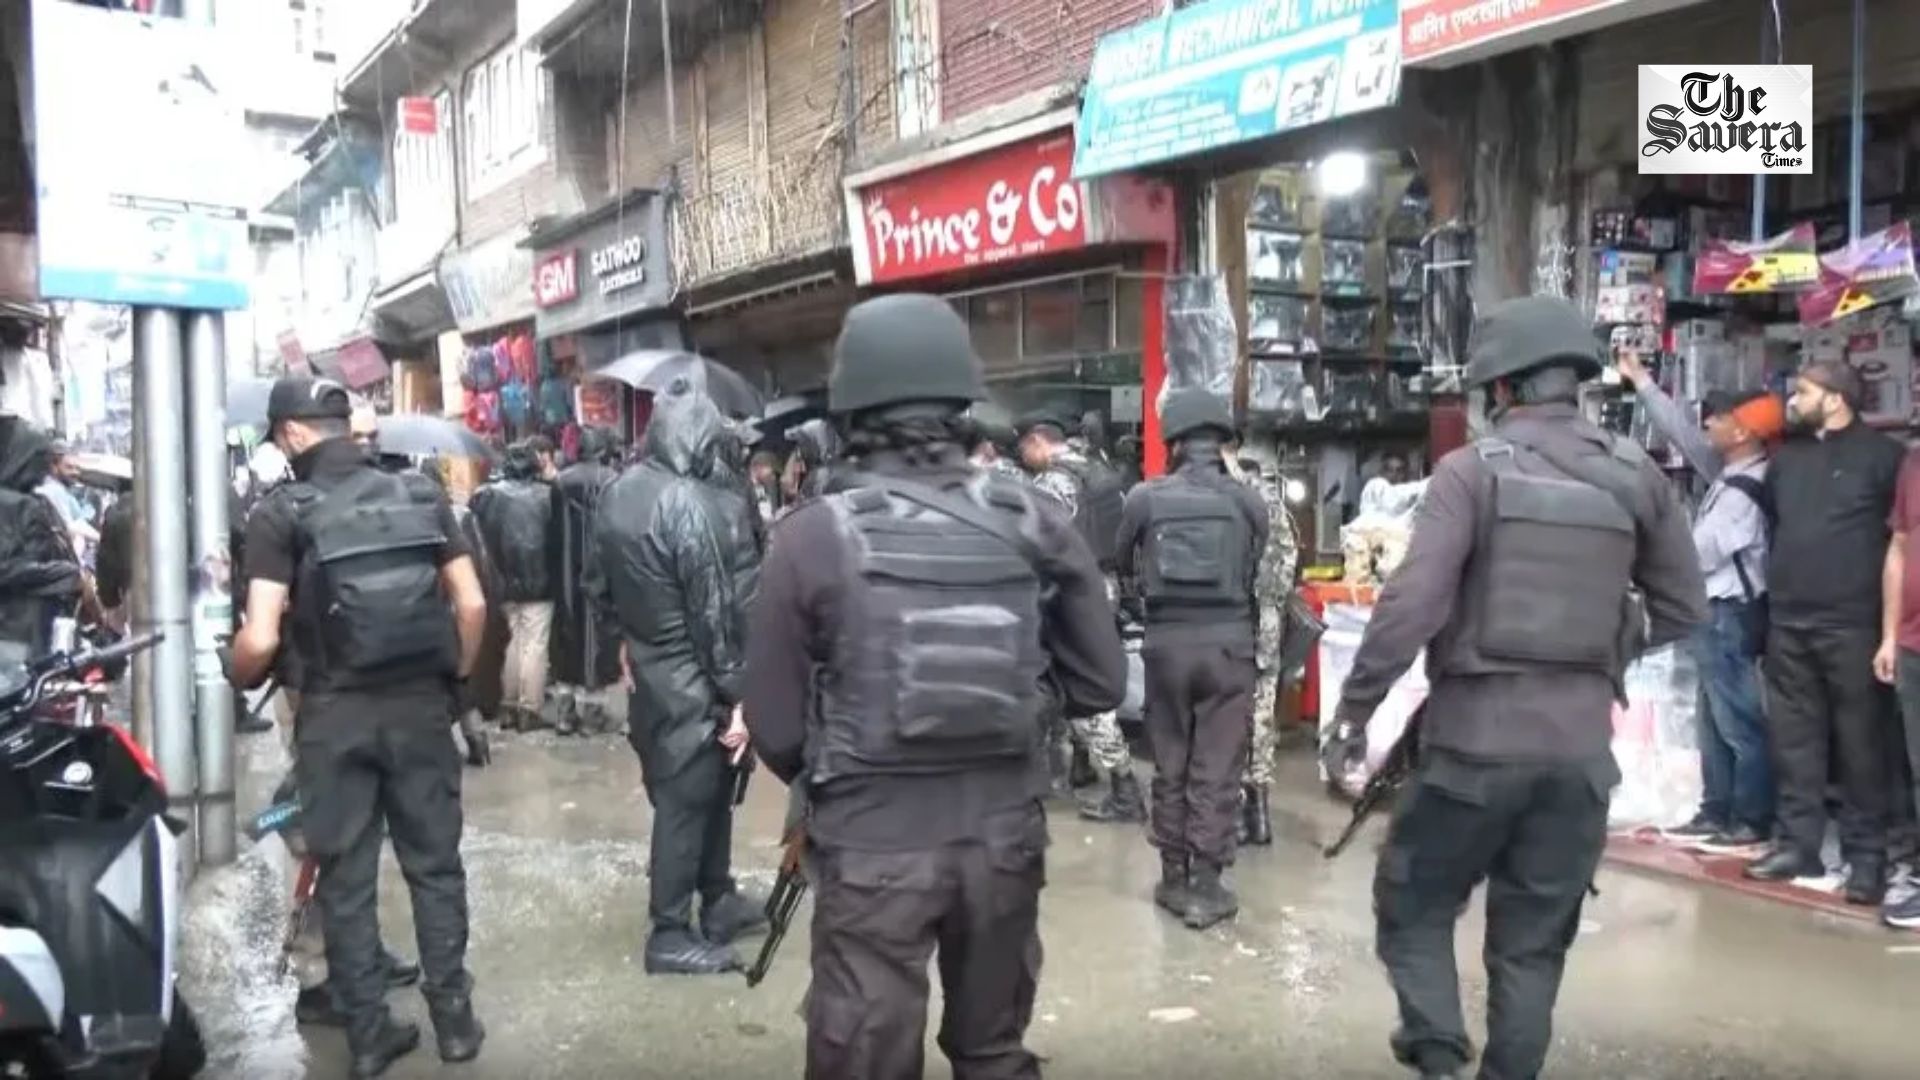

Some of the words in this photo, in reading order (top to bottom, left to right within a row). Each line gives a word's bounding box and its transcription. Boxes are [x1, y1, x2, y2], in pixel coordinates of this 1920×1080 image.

[869, 199, 981, 269] Prince
[985, 179, 1023, 245] &
[1028, 165, 1079, 237] Co
[537, 254, 576, 302] GM
